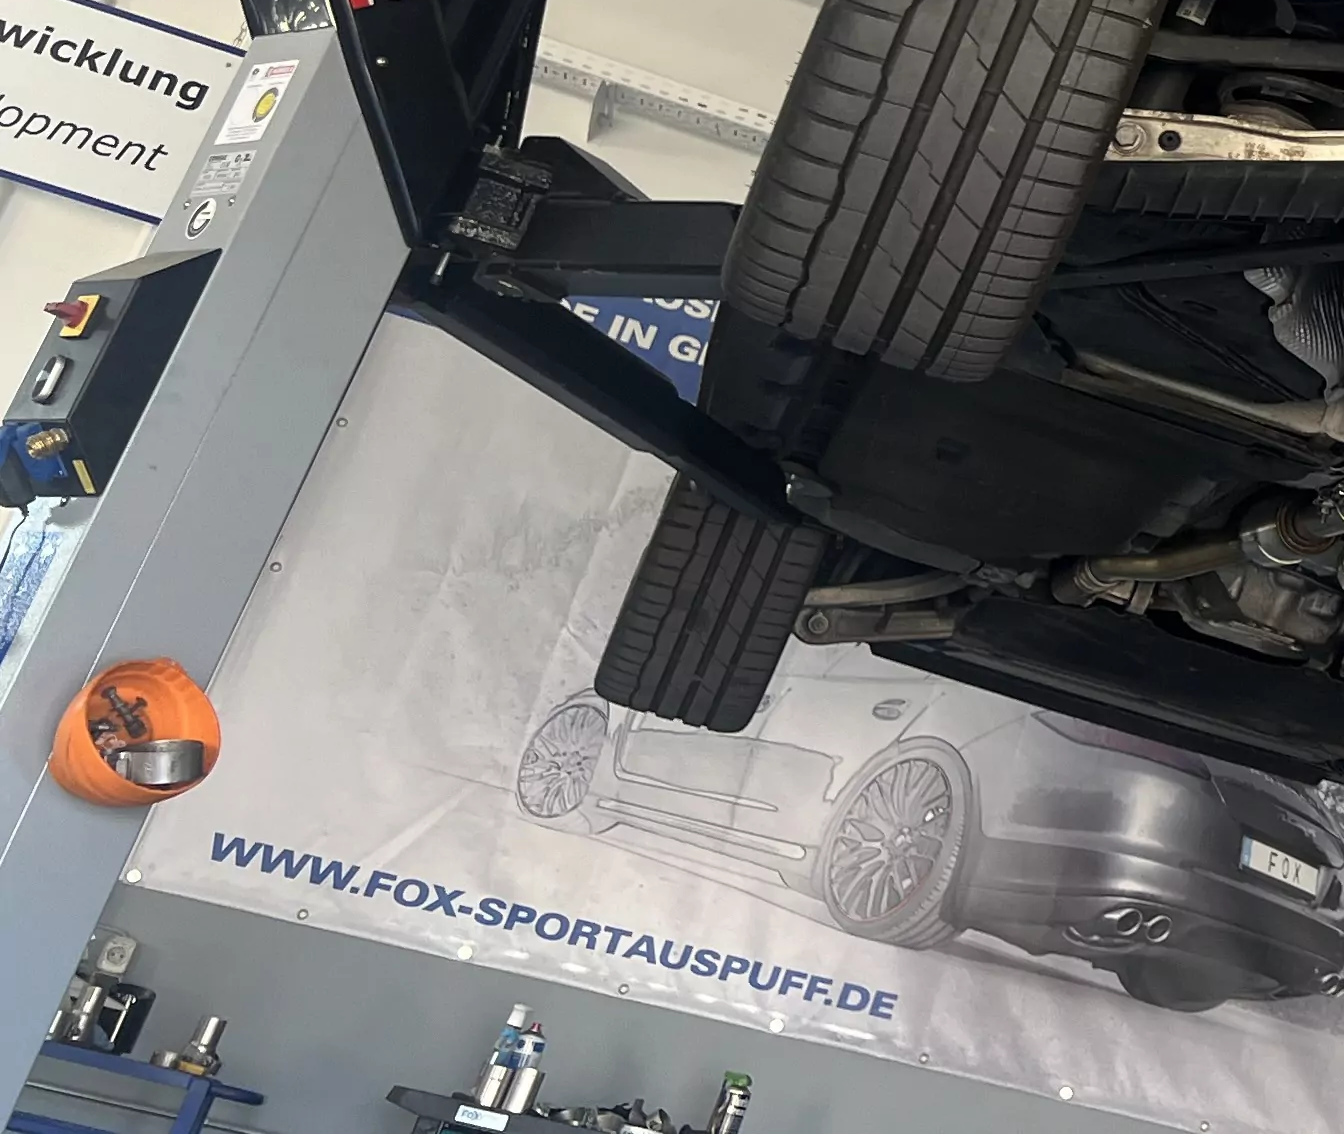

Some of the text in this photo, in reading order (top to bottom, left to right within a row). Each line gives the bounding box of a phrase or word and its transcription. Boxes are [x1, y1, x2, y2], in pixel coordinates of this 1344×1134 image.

[607, 315, 657, 350] IN
[1268, 851, 1302, 884] FOX
[210, 832, 898, 1020] WWW.FOX-SPORTAUSPUFF.DE
